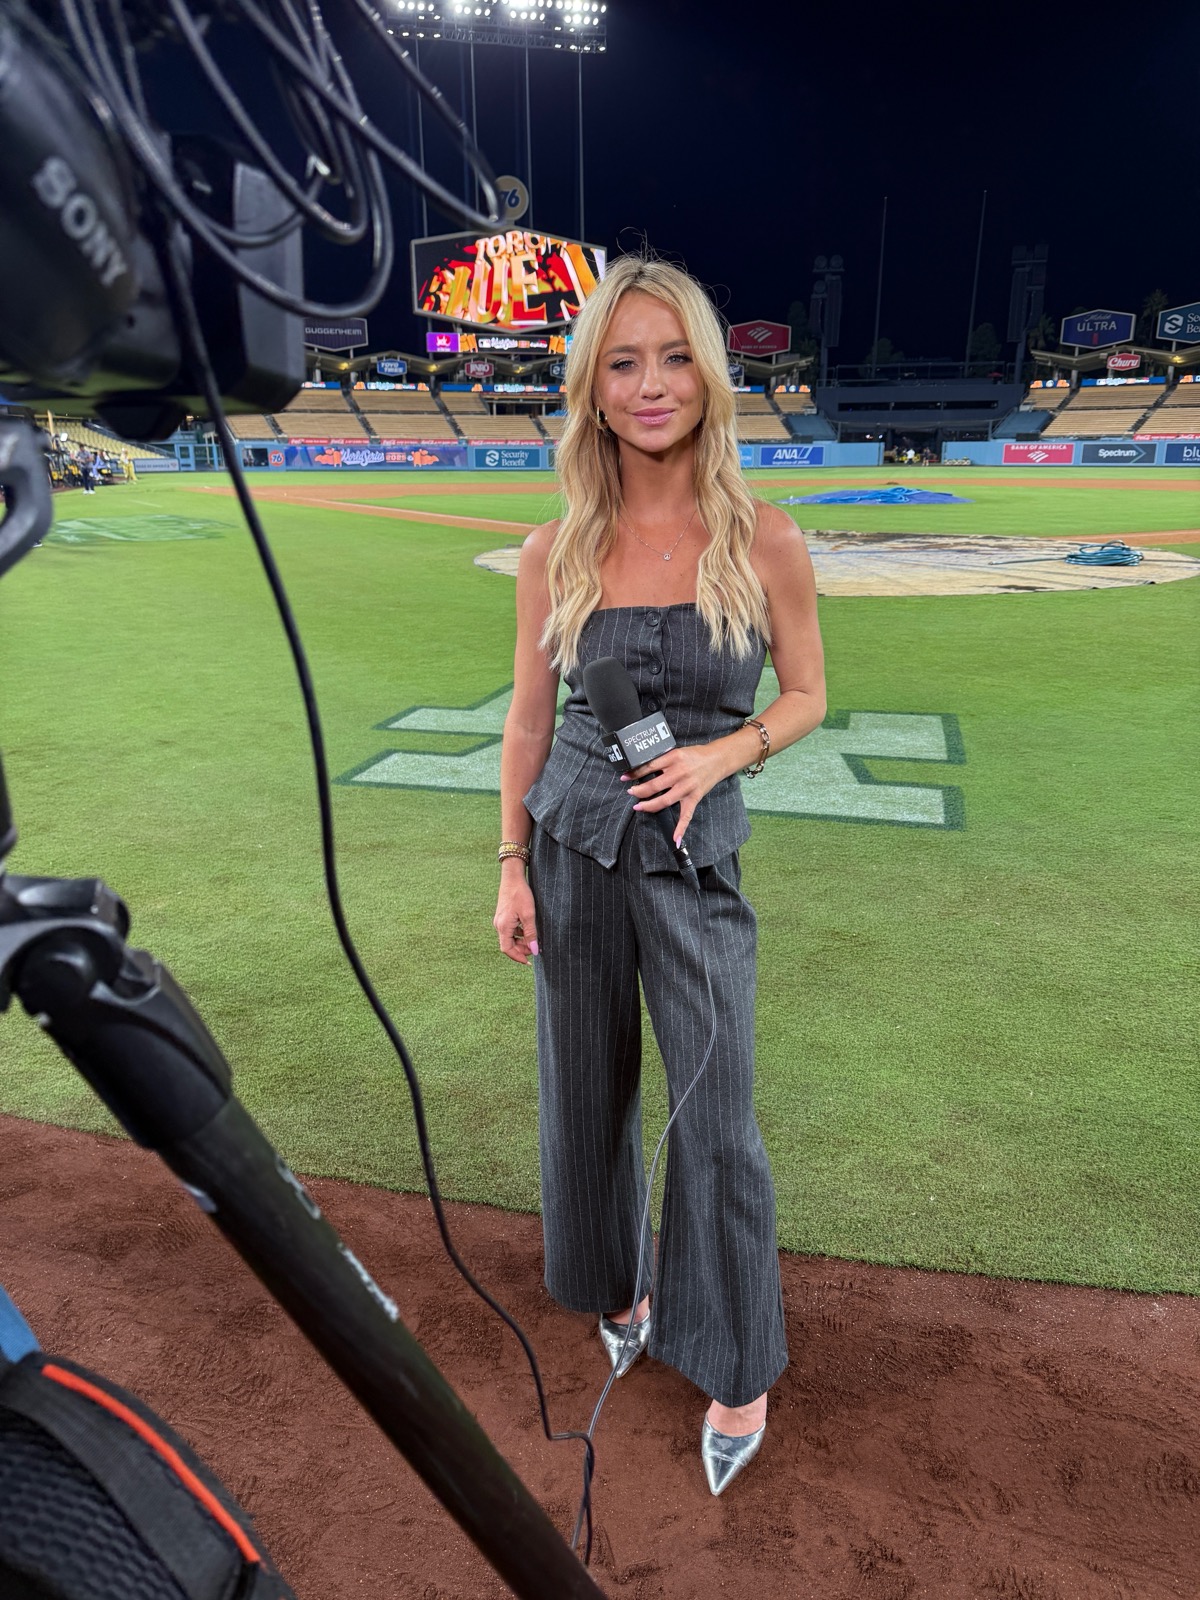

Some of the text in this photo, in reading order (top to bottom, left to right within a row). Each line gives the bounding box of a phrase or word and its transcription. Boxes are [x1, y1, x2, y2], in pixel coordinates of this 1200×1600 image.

[32, 158, 127, 288] SONY
[1187, 312, 1200, 323] Se
[305, 327, 362, 335] GUGGENHEIM
[1077, 320, 1117, 332] ULTRA
[1109, 357, 1139, 368] Churu
[271, 453, 283, 463] 76
[501, 450, 529, 461] Security
[772, 448, 798, 459] ANA
[1098, 448, 1137, 458] Spectrum
[501, 458, 526, 466] Benefit
[624, 726, 657, 747] SPECTRUM
[634, 733, 660, 753] NEWS
